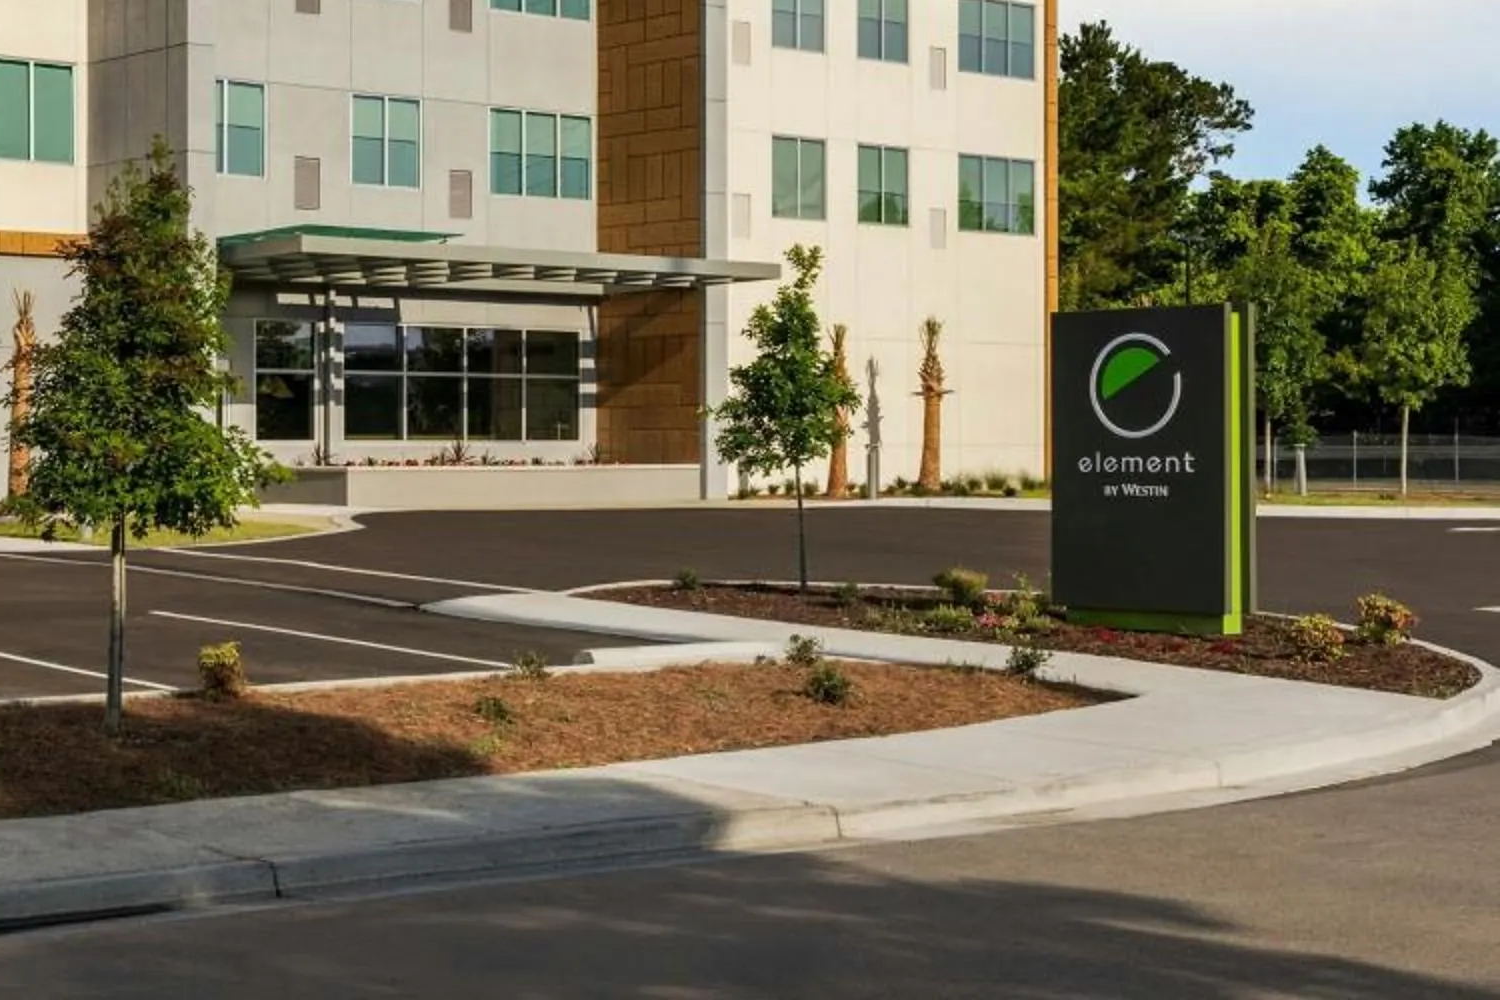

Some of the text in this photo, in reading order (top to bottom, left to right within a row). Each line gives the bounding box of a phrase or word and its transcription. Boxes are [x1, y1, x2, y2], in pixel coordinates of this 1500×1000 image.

[1078, 451, 1196, 473] element
[1103, 483, 1169, 497] BY WESTIN
